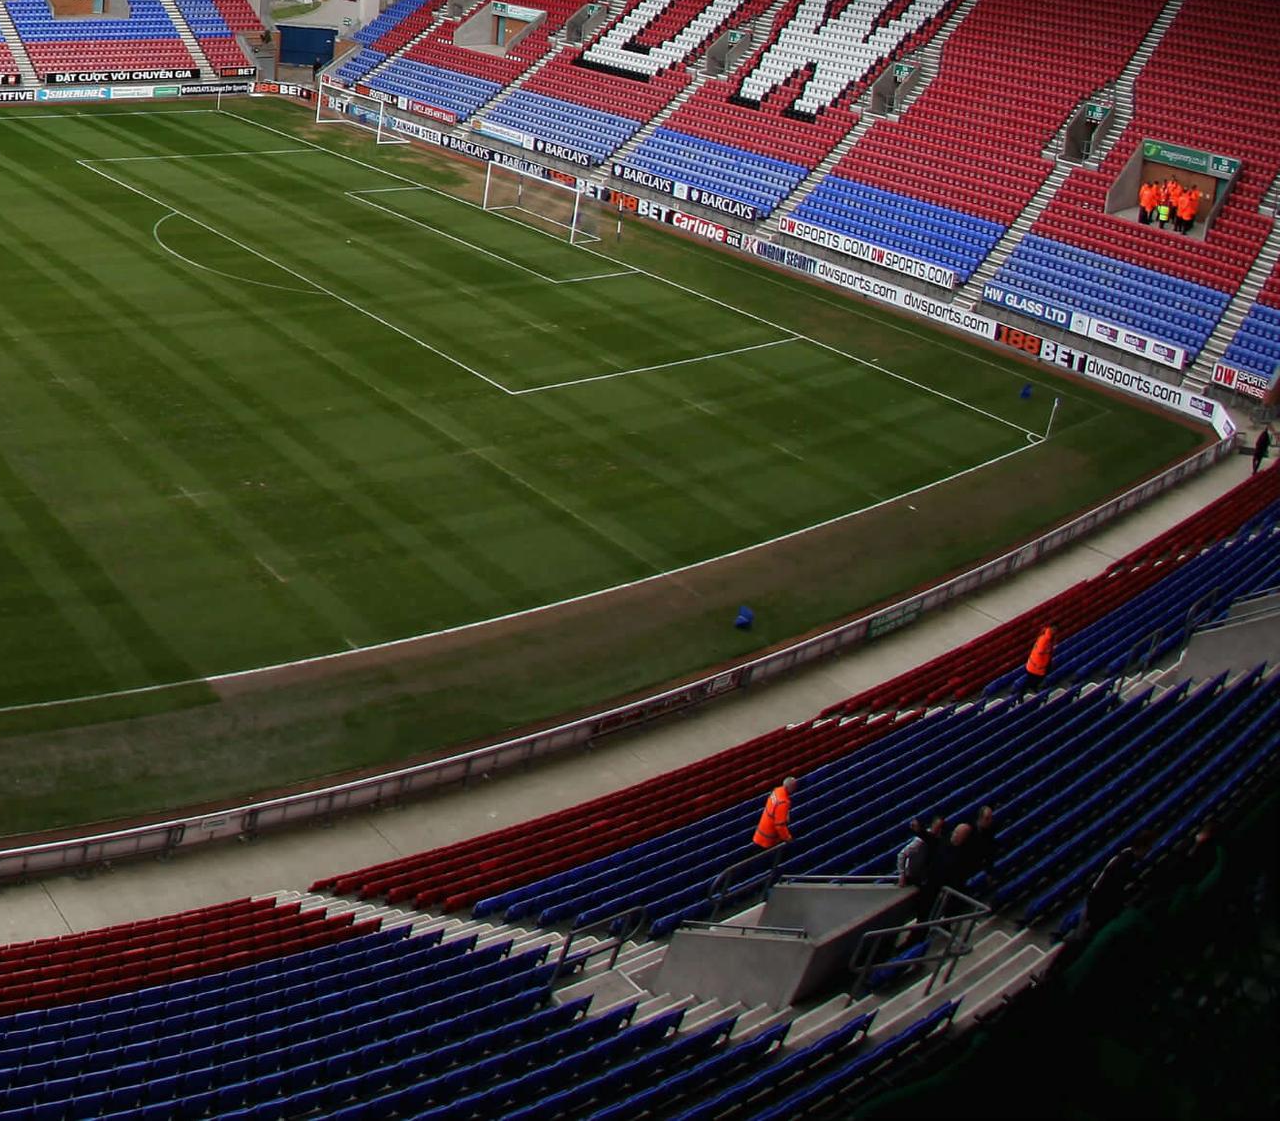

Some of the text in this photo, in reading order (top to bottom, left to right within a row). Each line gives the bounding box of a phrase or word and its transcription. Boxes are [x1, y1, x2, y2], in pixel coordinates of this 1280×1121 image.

[175, 70, 192, 78] GIA
[450, 138, 491, 160] BARCLAYS
[545, 142, 589, 166] BARCLAYS
[623, 167, 753, 220] BARCLAYS BARCLAYS
[672, 209, 725, 242] Carlube
[786, 251, 818, 274] SECURITY
[818, 261, 989, 334] dwsports.com dwsports.com
[984, 285, 1067, 324] HW GLASS LTD
[998, 325, 1082, 374] 188BET
[1087, 358, 1181, 406] dwsports.com
[1216, 365, 1268, 389] DW SPORTS
[1236, 381, 1266, 399] FITNESS
